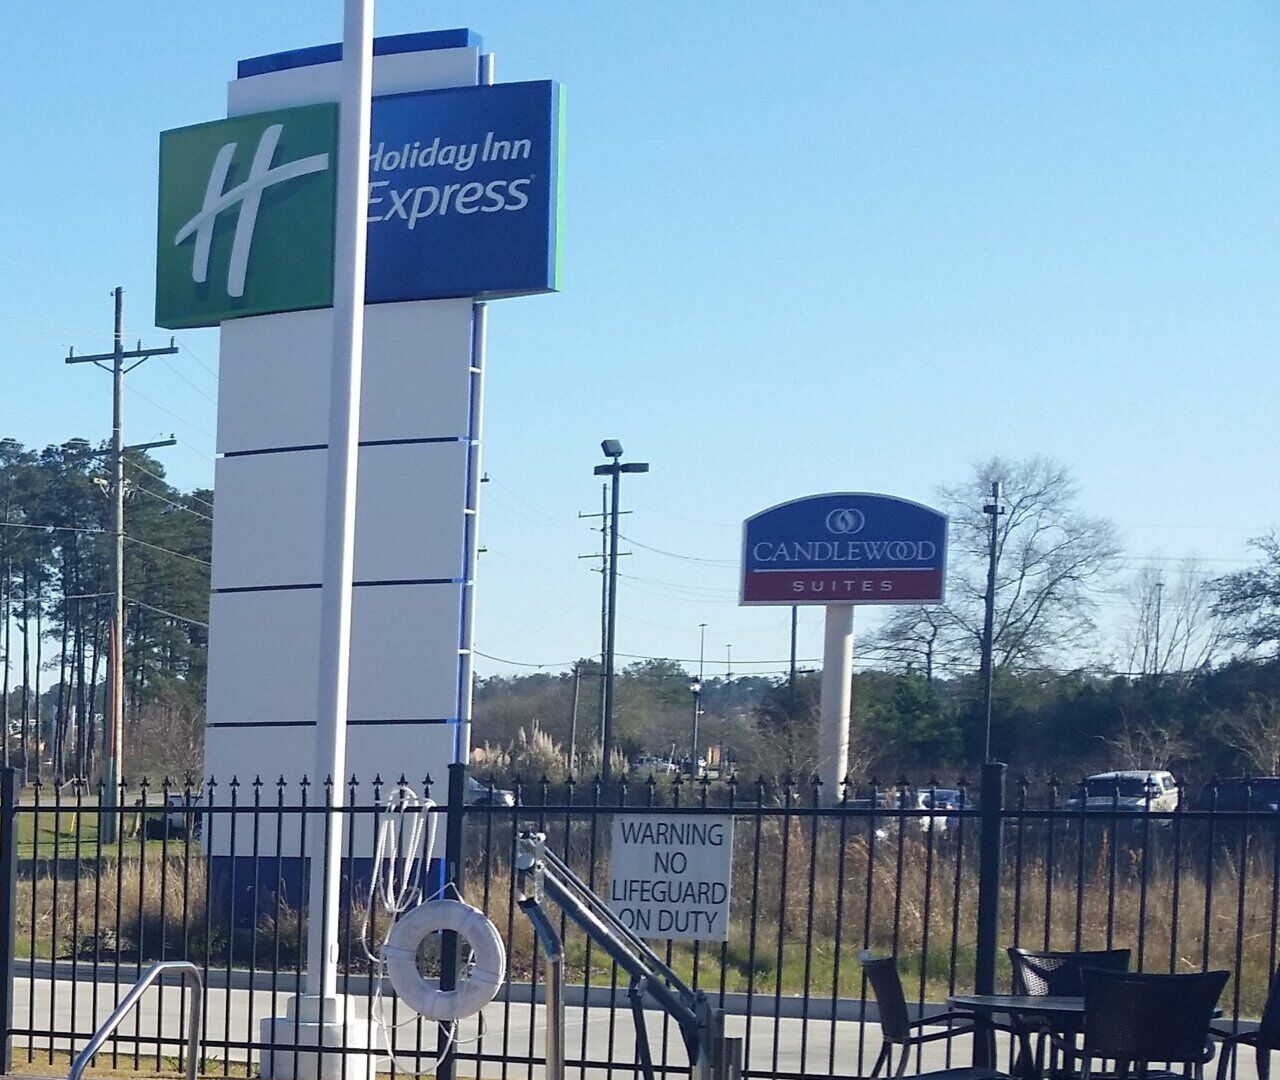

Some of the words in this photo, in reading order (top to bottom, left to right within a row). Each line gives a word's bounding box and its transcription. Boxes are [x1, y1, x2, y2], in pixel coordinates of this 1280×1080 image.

[369, 137, 478, 171] Holiday
[482, 131, 532, 162] Inn
[367, 178, 531, 230] Express
[753, 540, 936, 562] CANDLEWOOD
[793, 580, 893, 592] SUITES
[621, 822, 723, 846] WARNING
[654, 852, 688, 874] NO
[612, 879, 727, 904] LIFEGUARD
[618, 908, 651, 931] ON
[658, 909, 718, 934] DUTY
